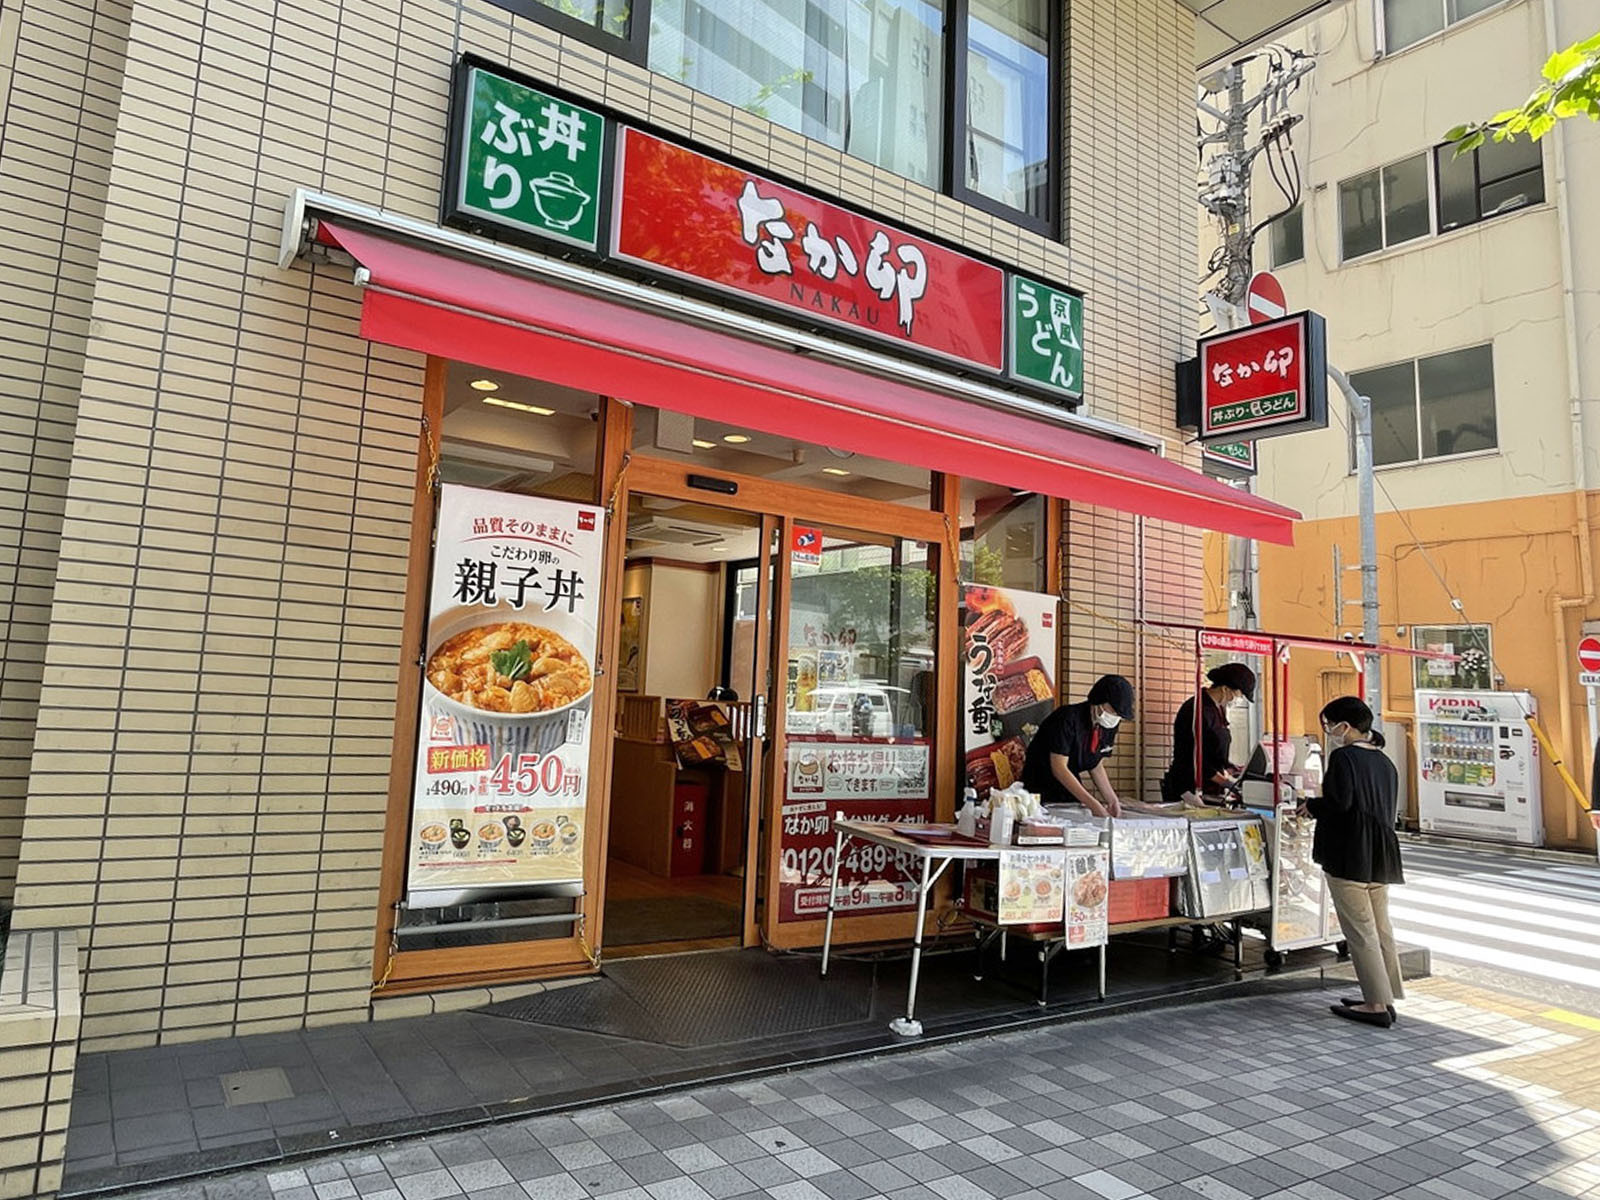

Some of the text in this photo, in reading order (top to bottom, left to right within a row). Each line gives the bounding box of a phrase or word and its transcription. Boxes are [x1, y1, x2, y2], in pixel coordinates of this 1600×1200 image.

[738, 180, 928, 337] なか卵
[789, 283, 880, 325] NAKAU
[1212, 347, 1294, 388] なか卵
[473, 517, 575, 545] 品質そのままに
[491, 544, 560, 566] こだわり卵の
[453, 558, 585, 613] 親子丼
[967, 634, 998, 735] うな重
[431, 749, 487, 769] 新価格
[489, 755, 582, 796] 450円
[682, 801, 695, 849] 消火器
[784, 815, 830, 836] なか卵
